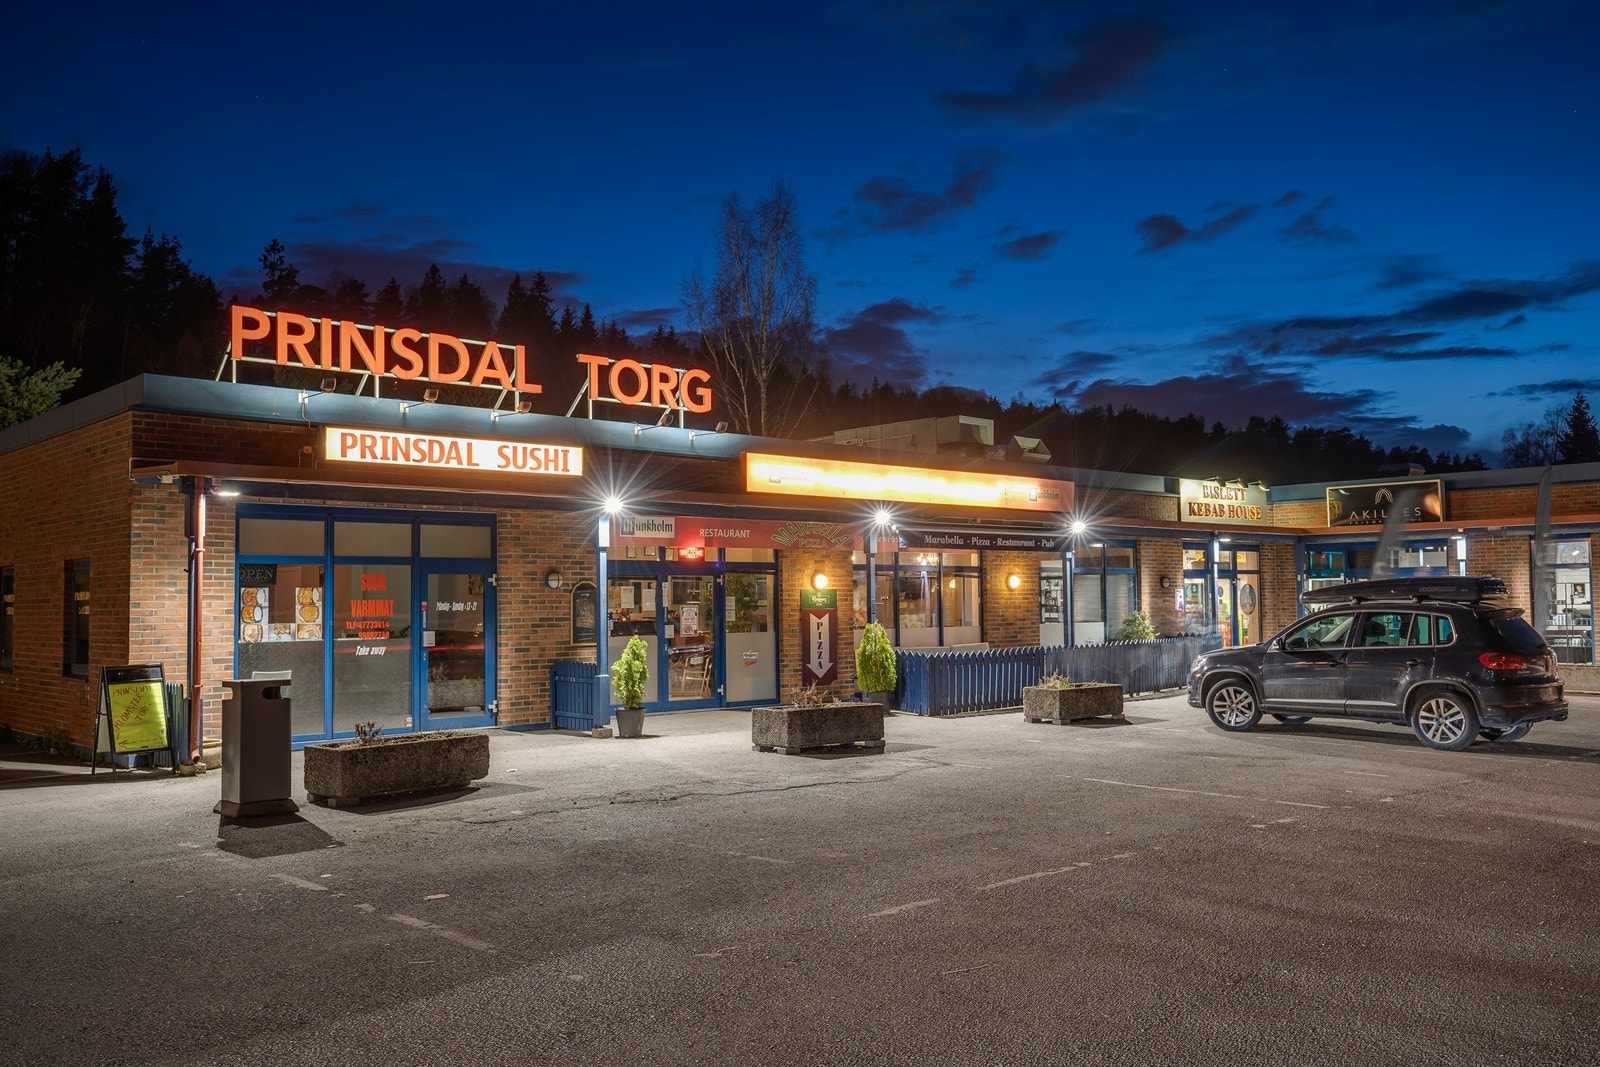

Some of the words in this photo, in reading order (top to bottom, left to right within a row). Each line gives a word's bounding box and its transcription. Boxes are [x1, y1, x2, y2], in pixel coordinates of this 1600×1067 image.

[231, 305, 542, 393] PRINSDAL
[577, 353, 712, 413] TORG
[340, 432, 479, 467] PRINSDAL
[497, 445, 570, 472] SUSHI
[1202, 485, 1246, 501] BISLETT
[1188, 502, 1225, 518] KEBAB
[1227, 504, 1262, 520] HOUSE
[1349, 506, 1421, 520] AKILES
[699, 528, 751, 539] RESTAURANT
[924, 534, 964, 546] Marabella
[971, 536, 990, 547] Pizza
[997, 537, 1035, 548] Restaurant
[1041, 539, 1054, 548] Pub
[799, 539, 828, 548] PIZZA
[361, 573, 387, 592] SUSHI
[350, 599, 395, 618] VARMMAT
[355, 646, 370, 656] Take
[370, 646, 387, 656] away
[816, 621, 824, 669] PIZZA
[114, 693, 144, 731] BLOMSTER
